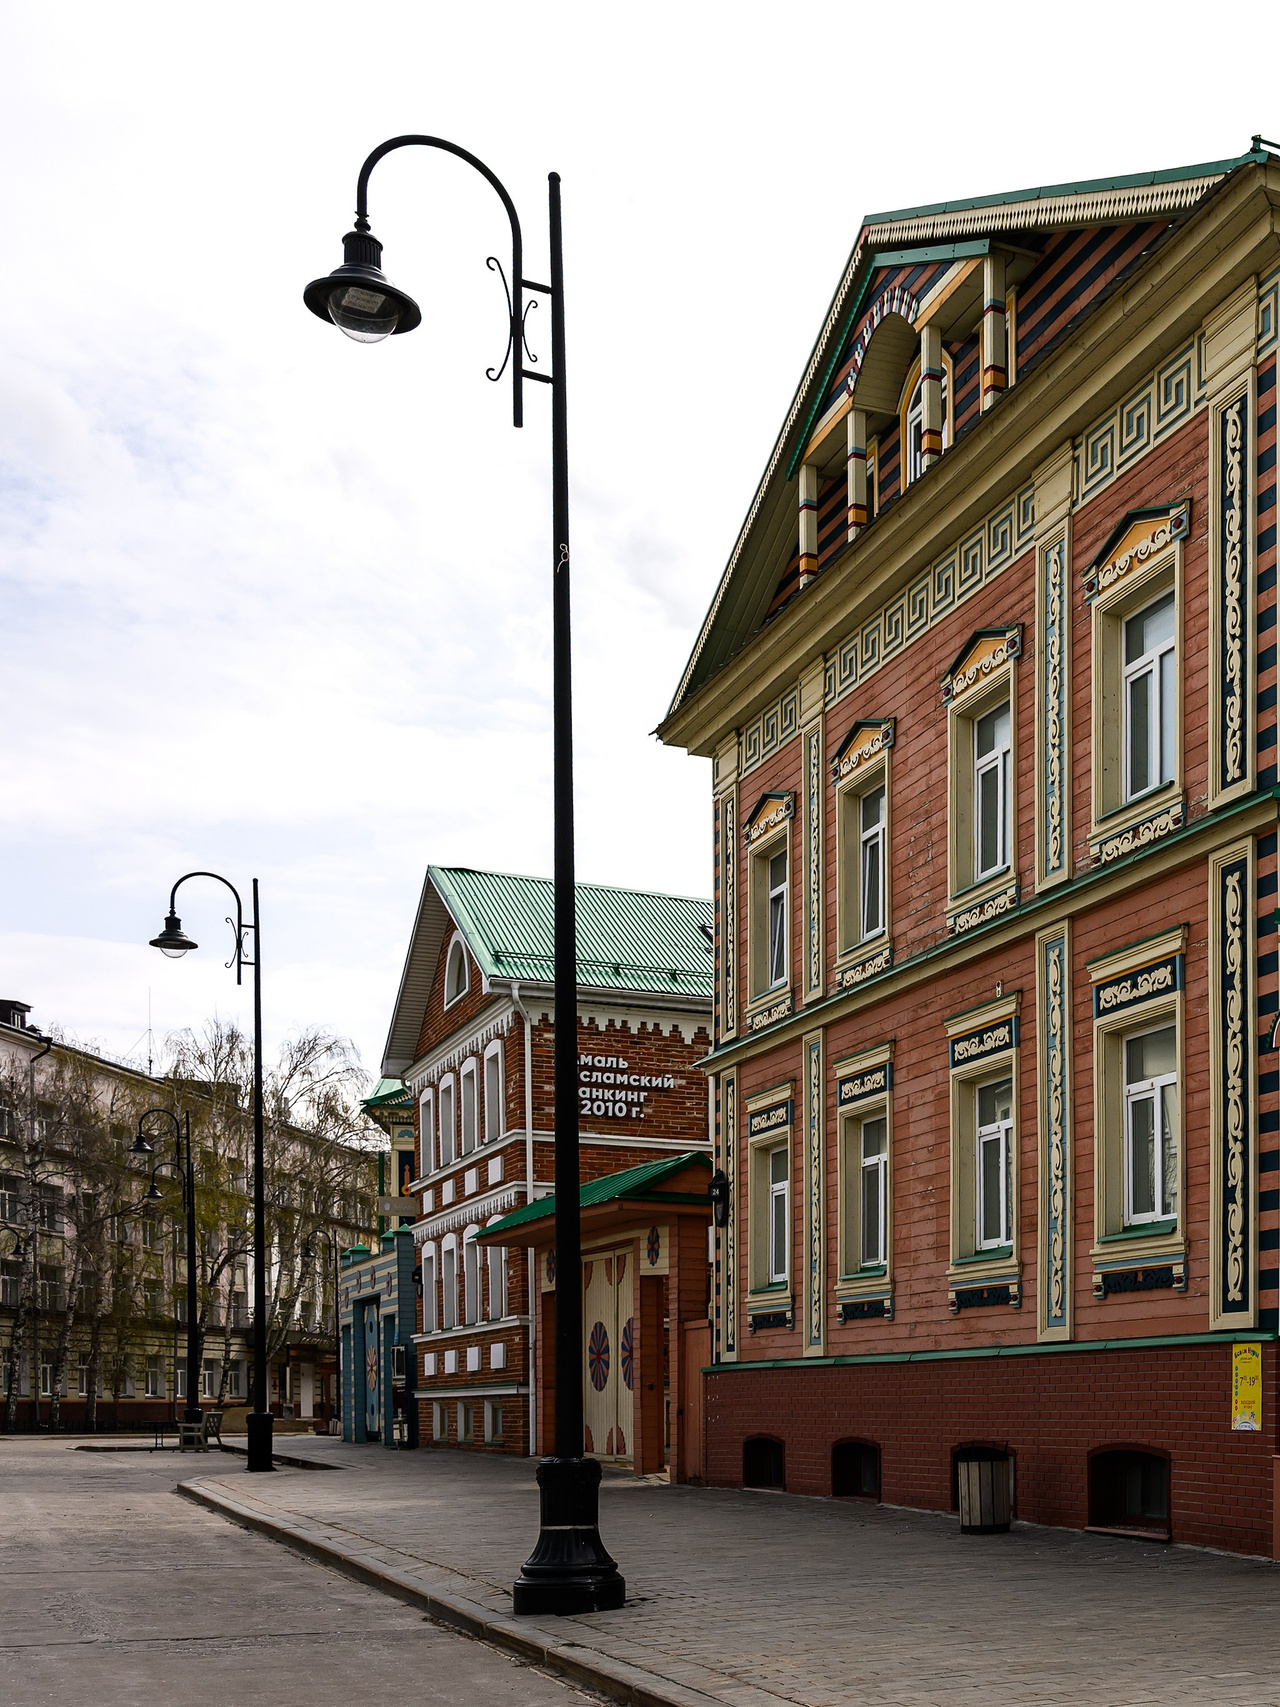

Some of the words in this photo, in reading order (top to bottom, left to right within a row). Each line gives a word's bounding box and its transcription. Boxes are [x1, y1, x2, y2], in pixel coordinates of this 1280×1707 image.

[577, 1054, 629, 1069] маль
[579, 1070, 675, 1089] сламский
[578, 1086, 648, 1103] анкинг
[580, 1100, 627, 1118] 2010
[631, 1107, 645, 1118] г.
